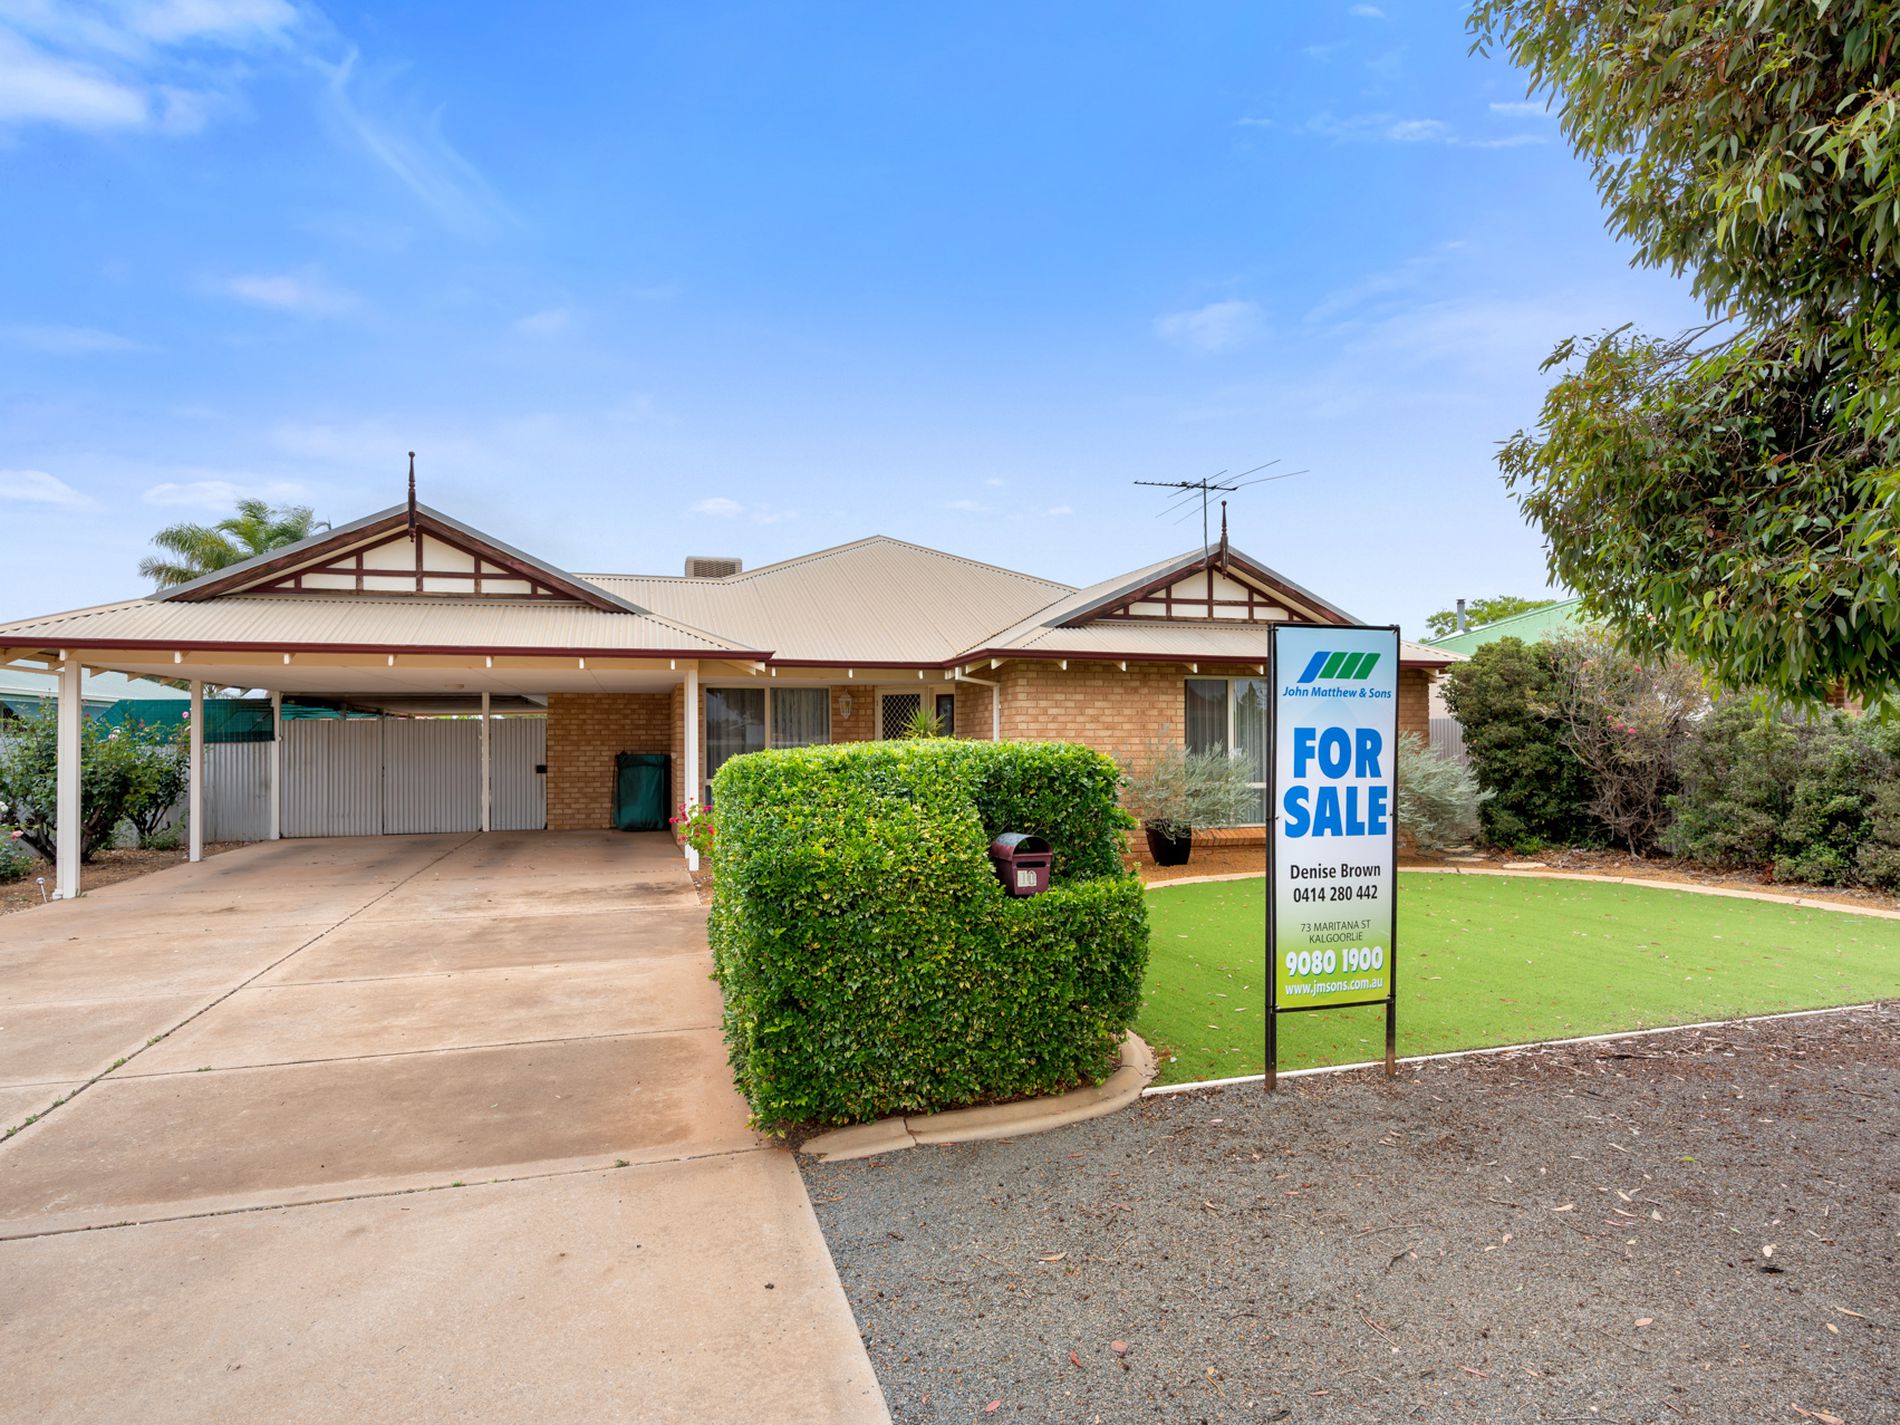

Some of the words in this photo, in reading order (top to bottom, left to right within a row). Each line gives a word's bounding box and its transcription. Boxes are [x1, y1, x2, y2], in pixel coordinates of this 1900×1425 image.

[1283, 687, 1308, 696] John
[1311, 687, 1357, 698] Matthew
[1359, 688, 1366, 698] &
[1369, 688, 1392, 698] Sons
[1294, 727, 1382, 779] FOR
[1283, 785, 1388, 838] SALE
[1290, 863, 1336, 879] Denise
[1341, 864, 1380, 878] Brown
[1294, 887, 1326, 902] 0414
[1330, 886, 1352, 901] 280
[1356, 885, 1378, 900] 442
[1301, 924, 1312, 932] 73
[1314, 920, 1359, 932] MARITANA
[1361, 920, 1371, 930] ST
[1309, 932, 1363, 944] KALGOORLIE
[1286, 950, 1336, 976] 9080
[1342, 946, 1383, 972] 1900
[1285, 978, 1383, 997] www.jmsons.com.au
